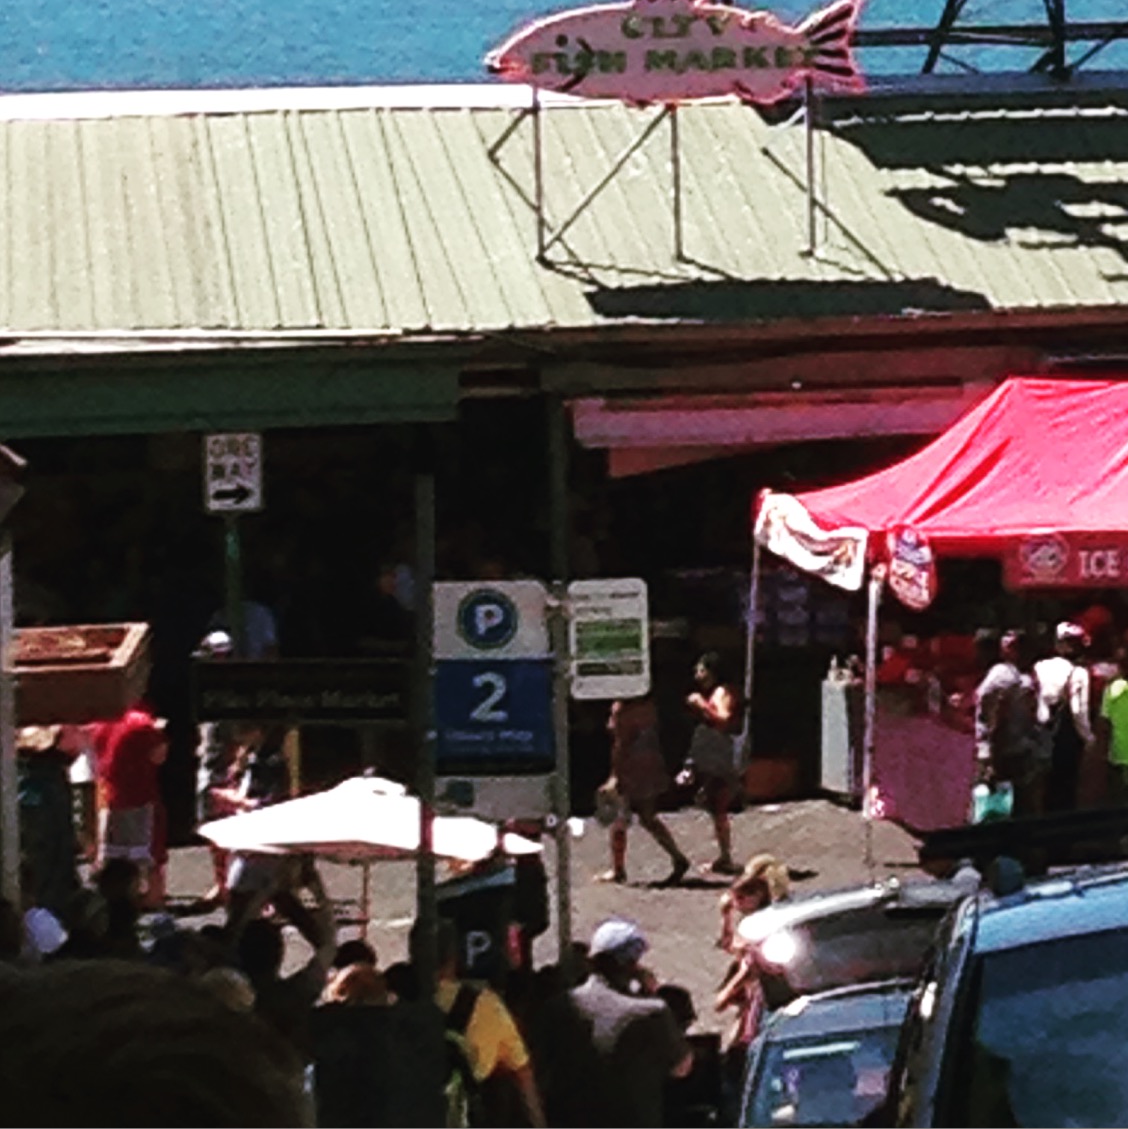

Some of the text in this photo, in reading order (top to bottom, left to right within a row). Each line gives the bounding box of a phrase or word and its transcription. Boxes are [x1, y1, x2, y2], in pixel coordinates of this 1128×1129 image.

[620, 13, 730, 40] CITY
[643, 44, 820, 74] MARKET
[1078, 550, 1119, 578] ICE
[474, 603, 504, 636] P
[470, 672, 509, 721] 2
[465, 929, 493, 967] P
